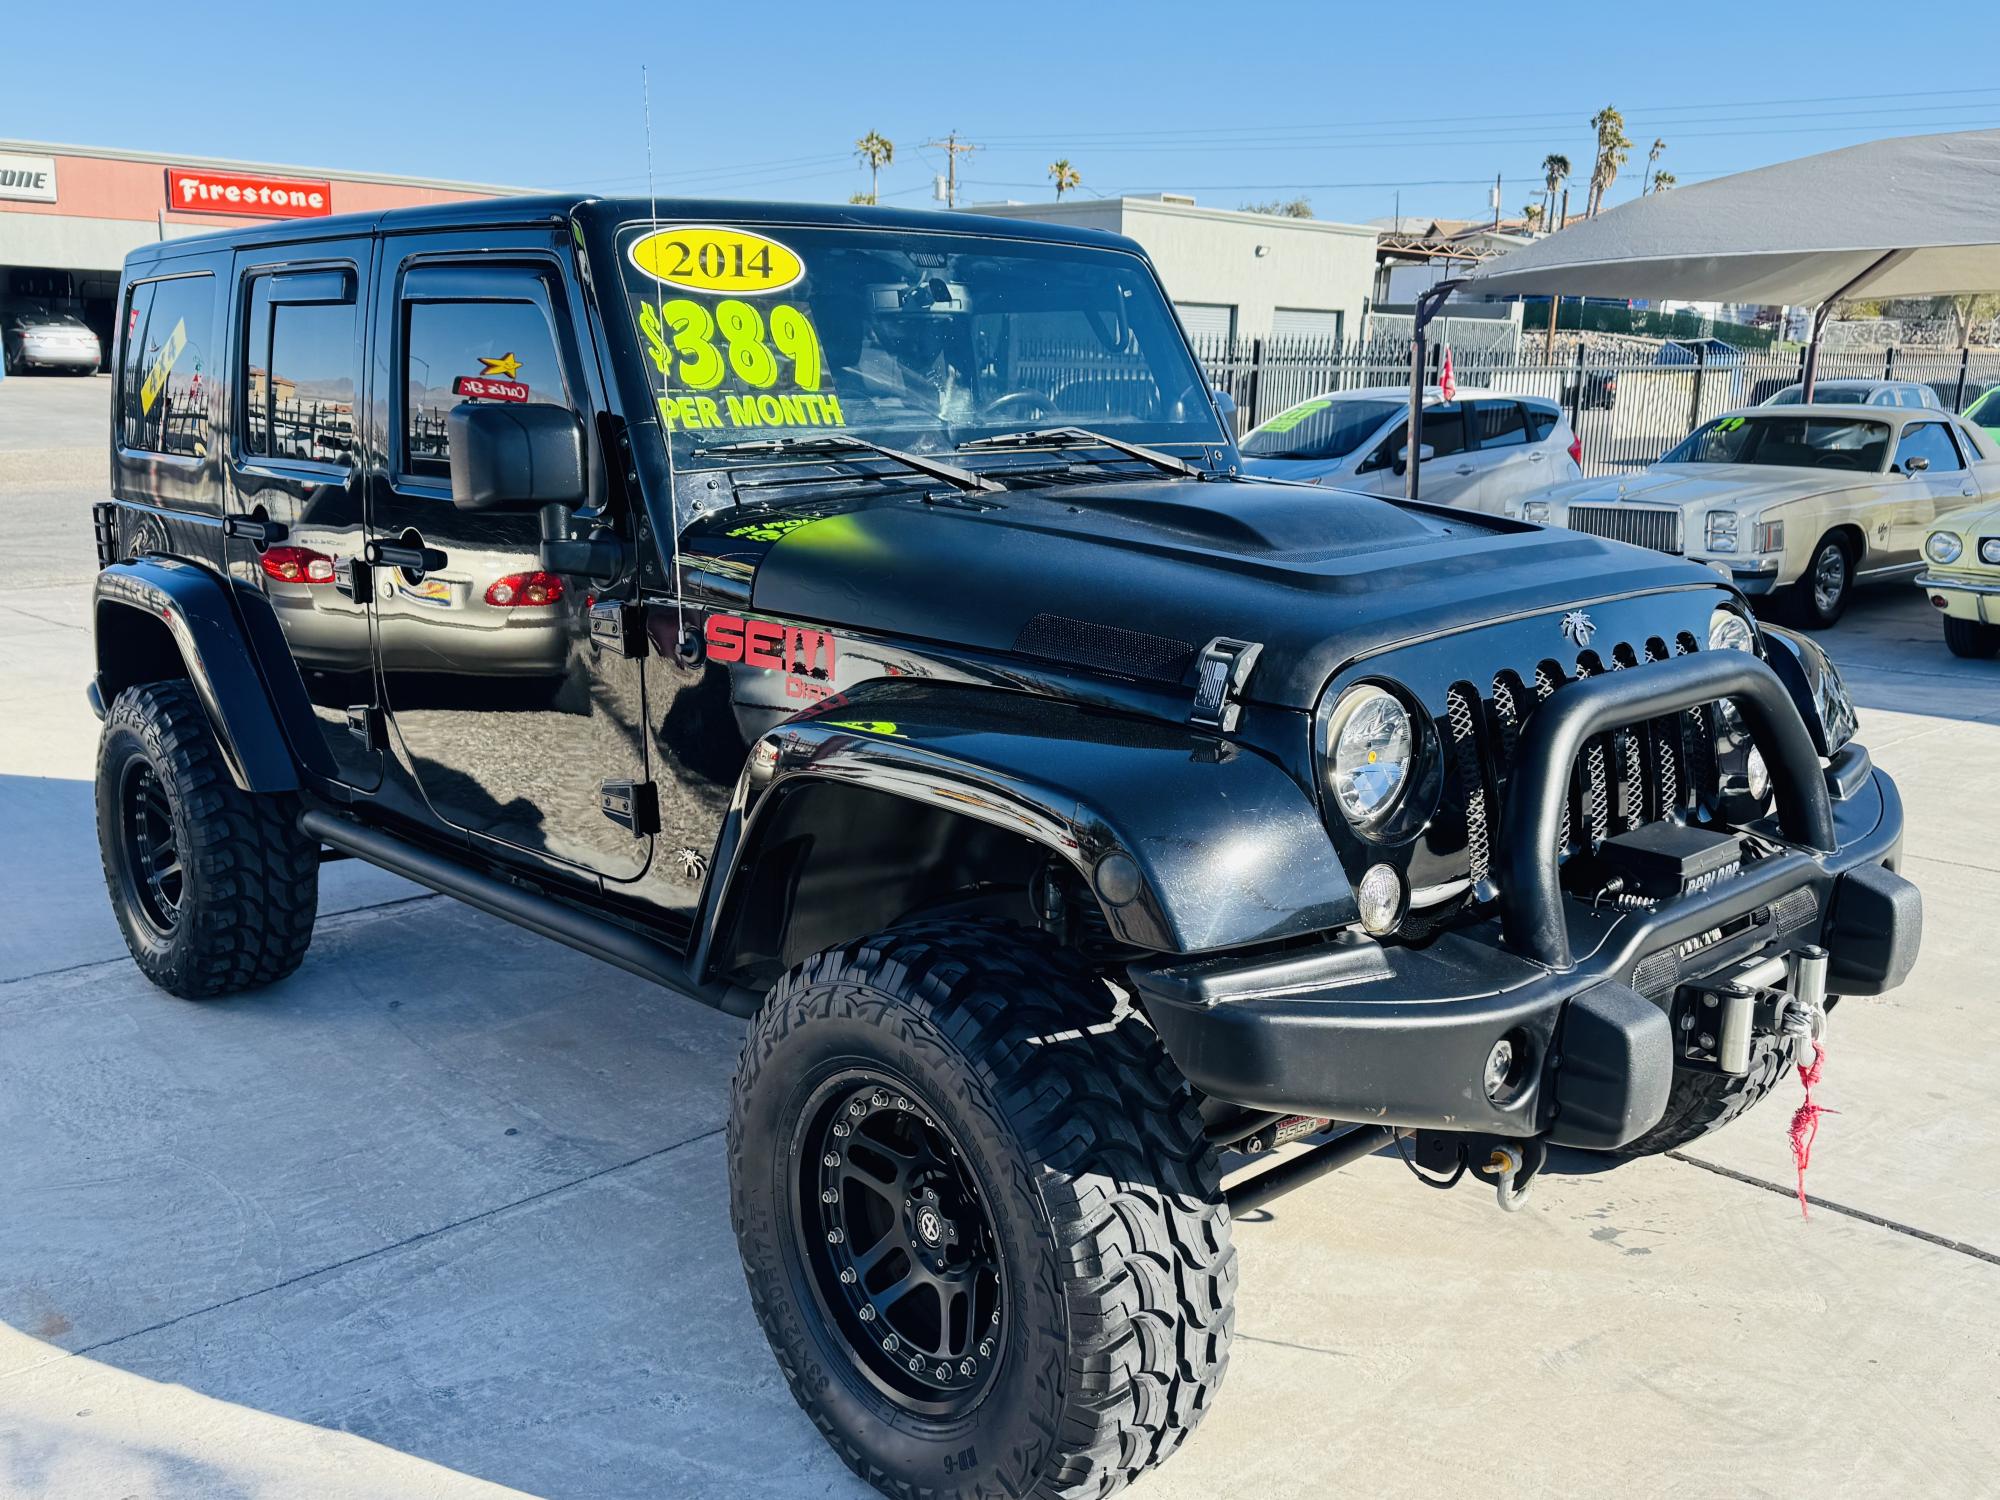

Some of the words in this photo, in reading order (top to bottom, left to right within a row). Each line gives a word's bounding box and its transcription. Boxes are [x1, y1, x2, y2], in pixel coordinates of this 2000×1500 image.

[0, 169, 47, 189] ONE
[179, 178, 324, 209] Firestone
[665, 241, 774, 279] 2014
[639, 299, 821, 392] $389
[657, 395, 724, 432] PER
[725, 394, 847, 427] MONTH
